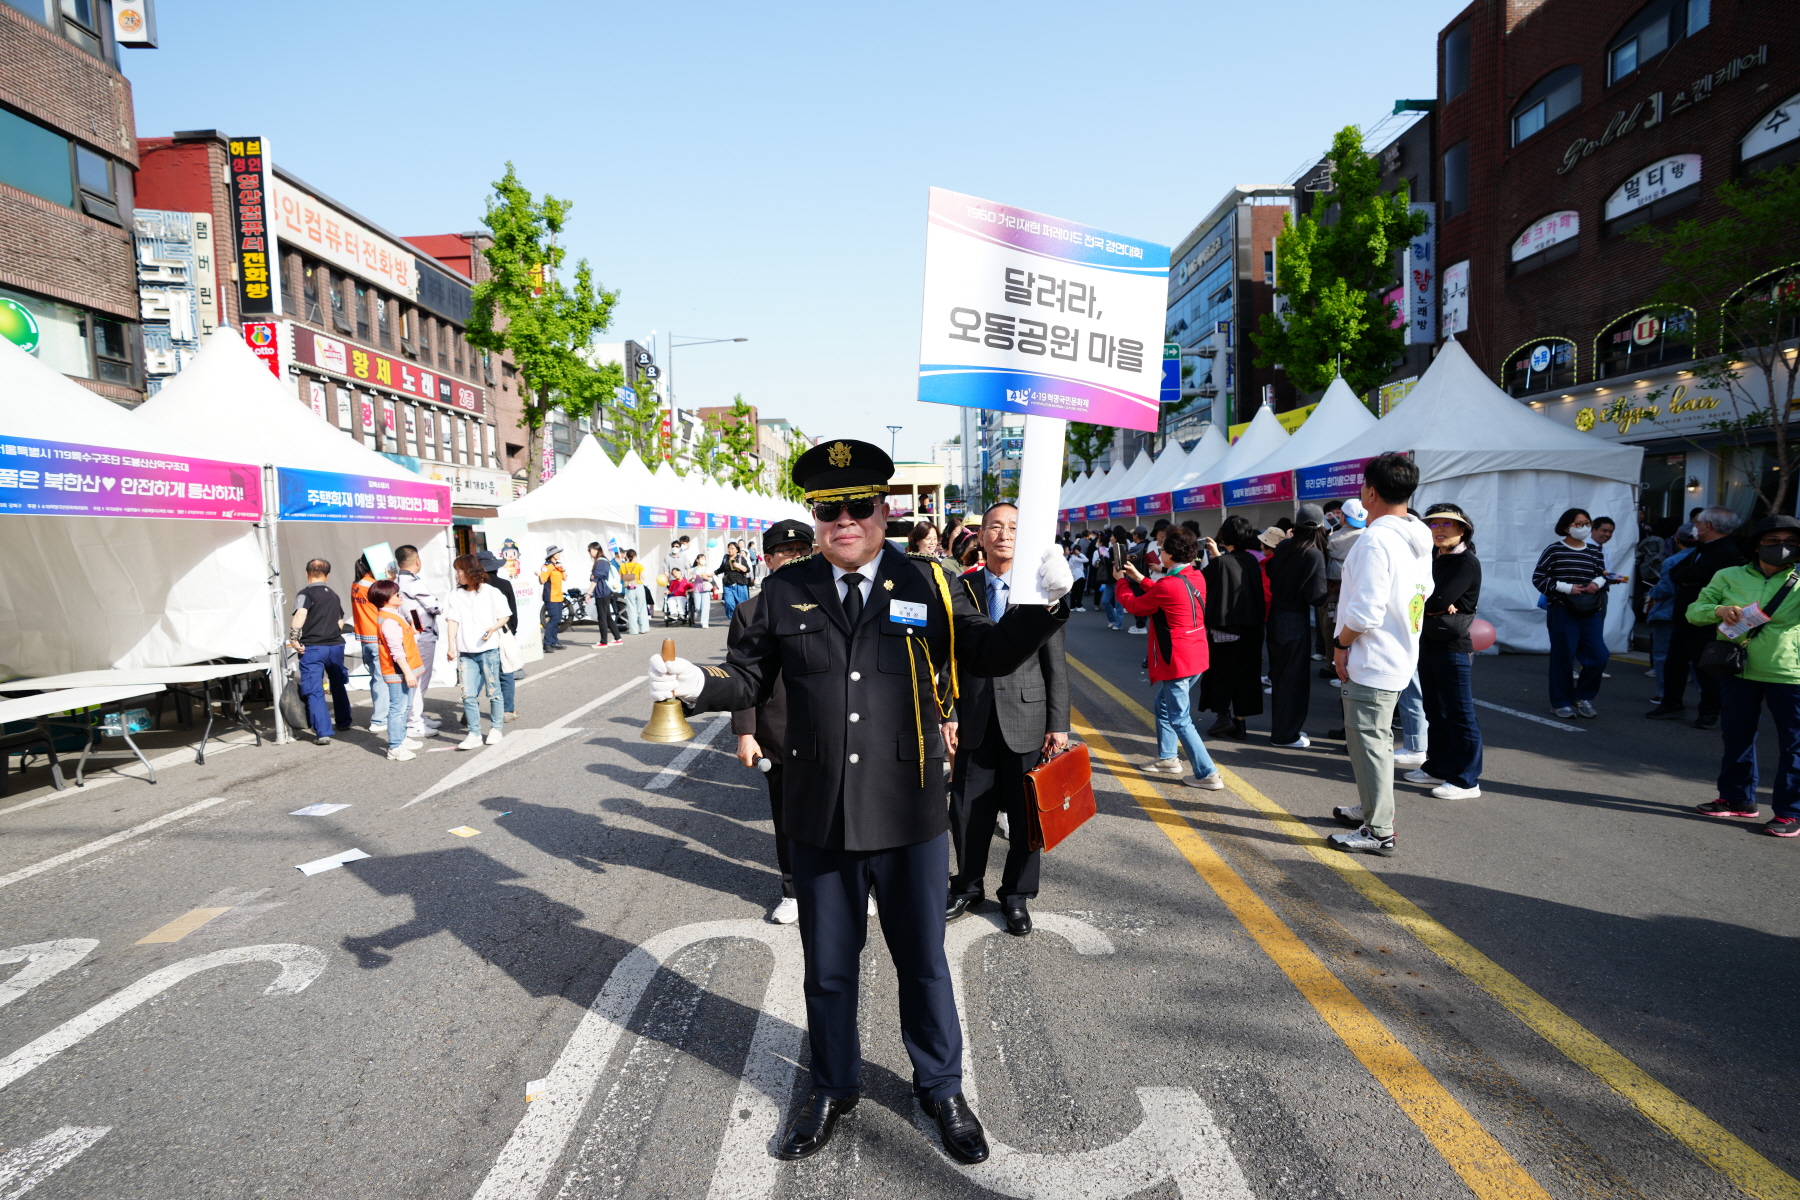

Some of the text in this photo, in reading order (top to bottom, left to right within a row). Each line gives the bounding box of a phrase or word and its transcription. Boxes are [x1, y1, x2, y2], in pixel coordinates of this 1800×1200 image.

[124, 16, 136, 25] 2F
[229, 140, 262, 157] 허브
[1624, 162, 1686, 201] 멀티방
[966, 206, 1143, 260] 1960 거리재현 퍼레이드 전국 경연대회
[1520, 213, 1571, 247] 토크카페
[1004, 266, 1103, 321] 달려라,
[1416, 295, 1428, 331] 노래방
[948, 306, 1144, 374] 오동공원 마을
[351, 348, 393, 387] 황제
[401, 365, 435, 399] 노래
[458, 387, 475, 410] 2층
[1047, 393, 1090, 409] 혁명국민문화제
[1669, 385, 1721, 415] hair
[53, 449, 121, 466] 119특수구조단
[43, 471, 101, 493] 북한산
[120, 477, 186, 498] 안전하게
[187, 482, 244, 502] 등산하자!
[1304, 478, 1315, 490] 우리
[1326, 474, 1356, 488] 한마음으로
[307, 489, 353, 508] 주택화재
[353, 493, 375, 509] 예방
[387, 495, 422, 512] 화재안전
[422, 497, 440, 513] 체험
